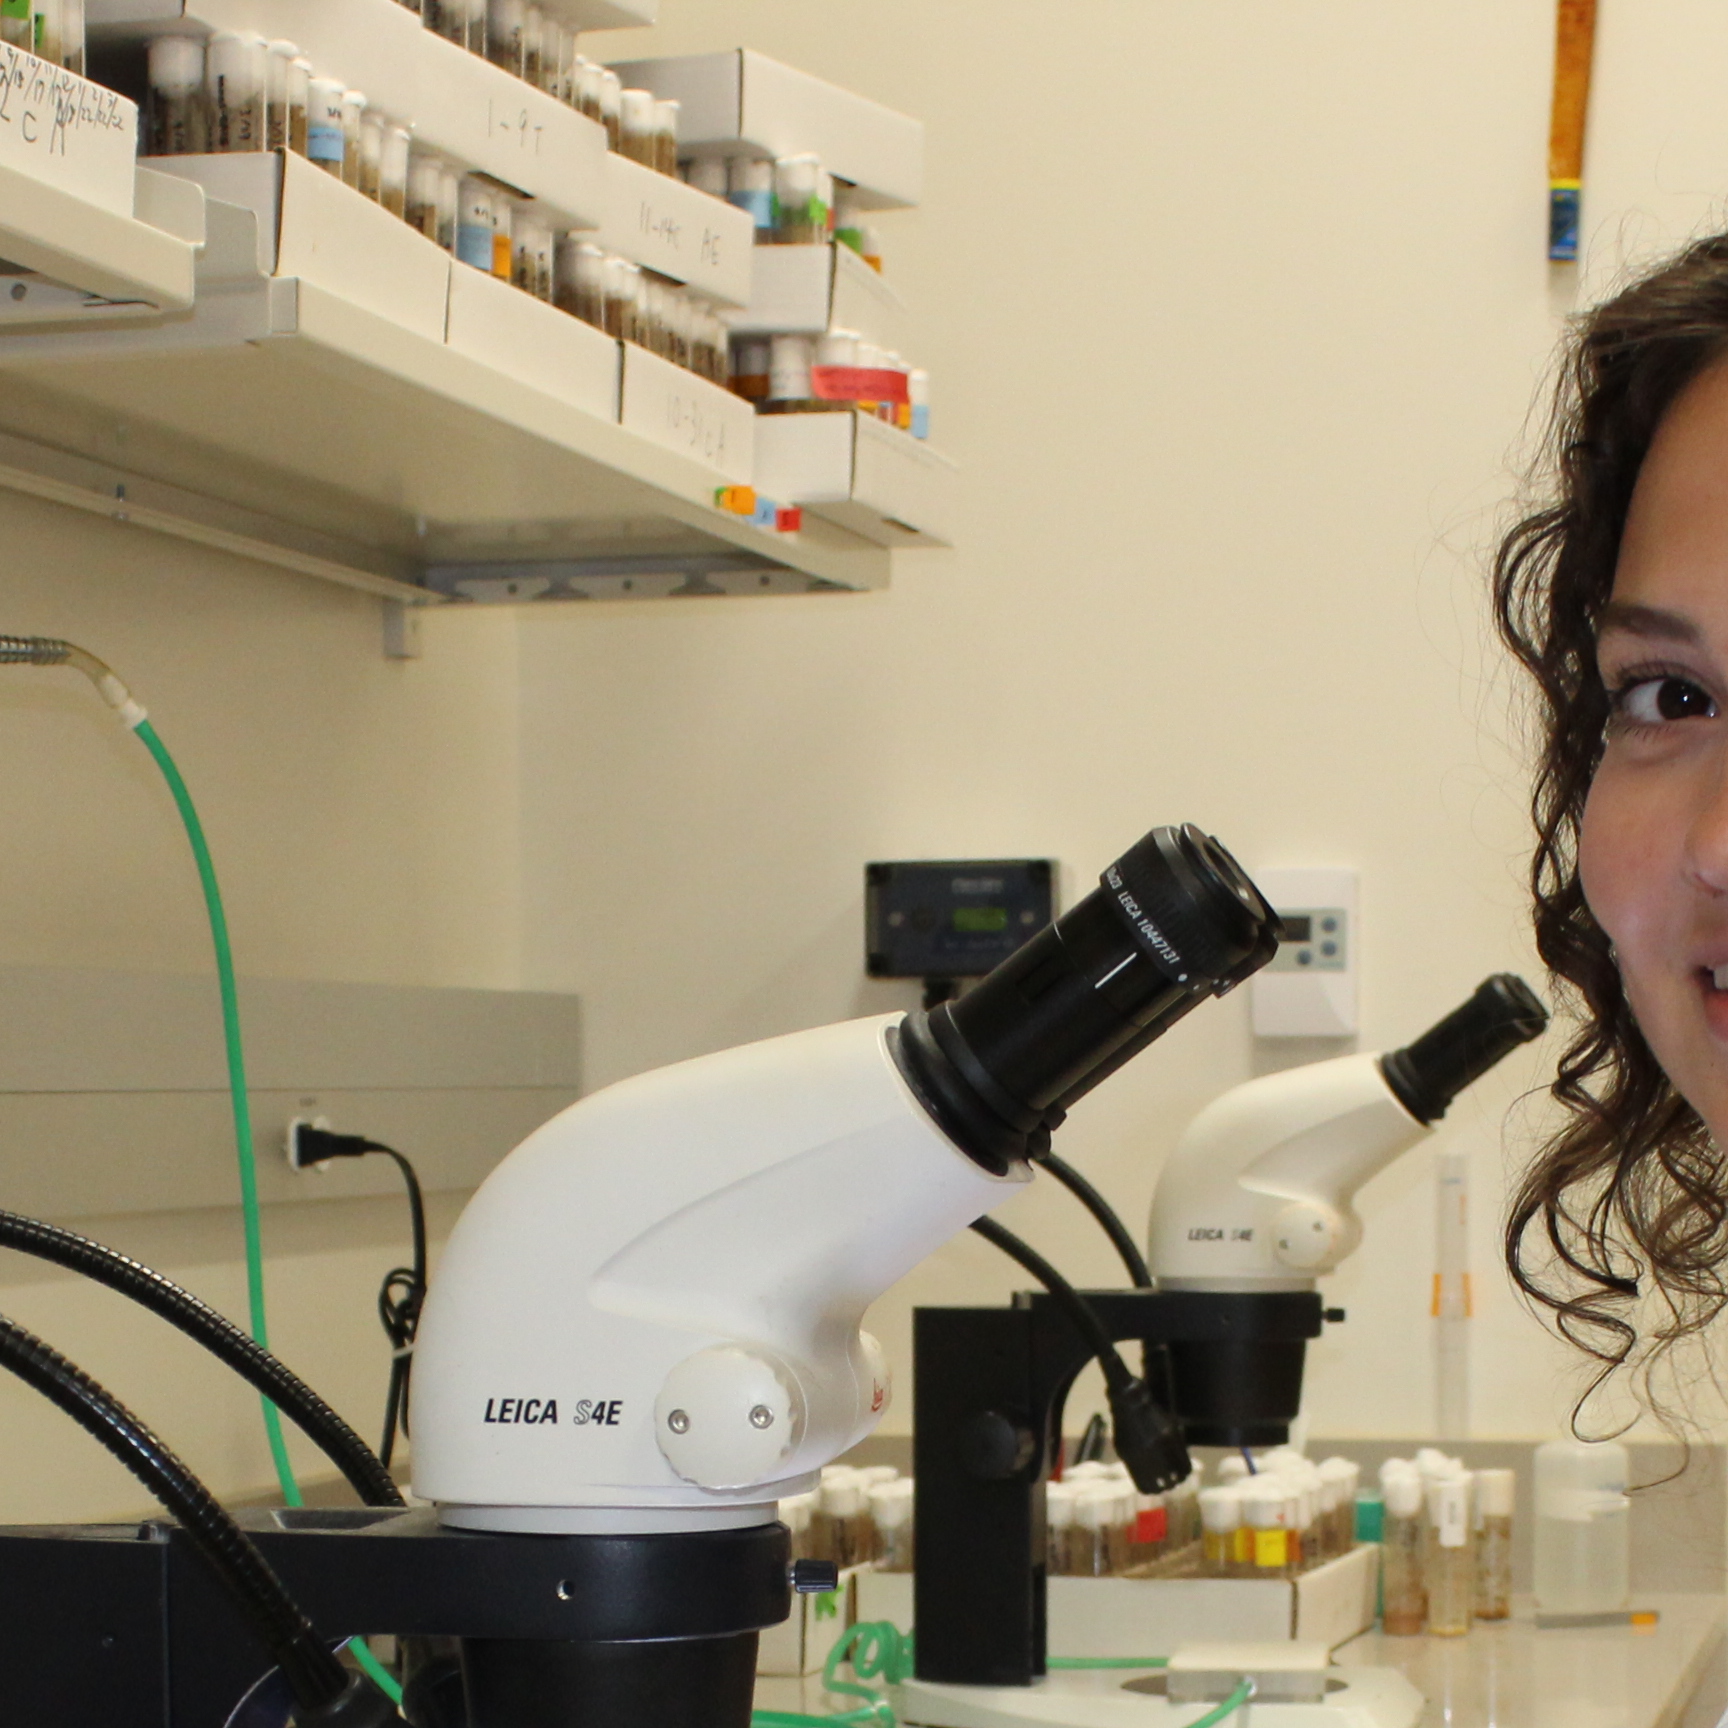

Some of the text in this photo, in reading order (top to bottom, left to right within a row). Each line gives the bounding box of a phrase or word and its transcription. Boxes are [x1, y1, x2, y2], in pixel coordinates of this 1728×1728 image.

[1117, 890, 1142, 919] LEICA
[1137, 918, 1180, 964] 10447131
[484, 1398, 623, 1426] LEICA S4E
